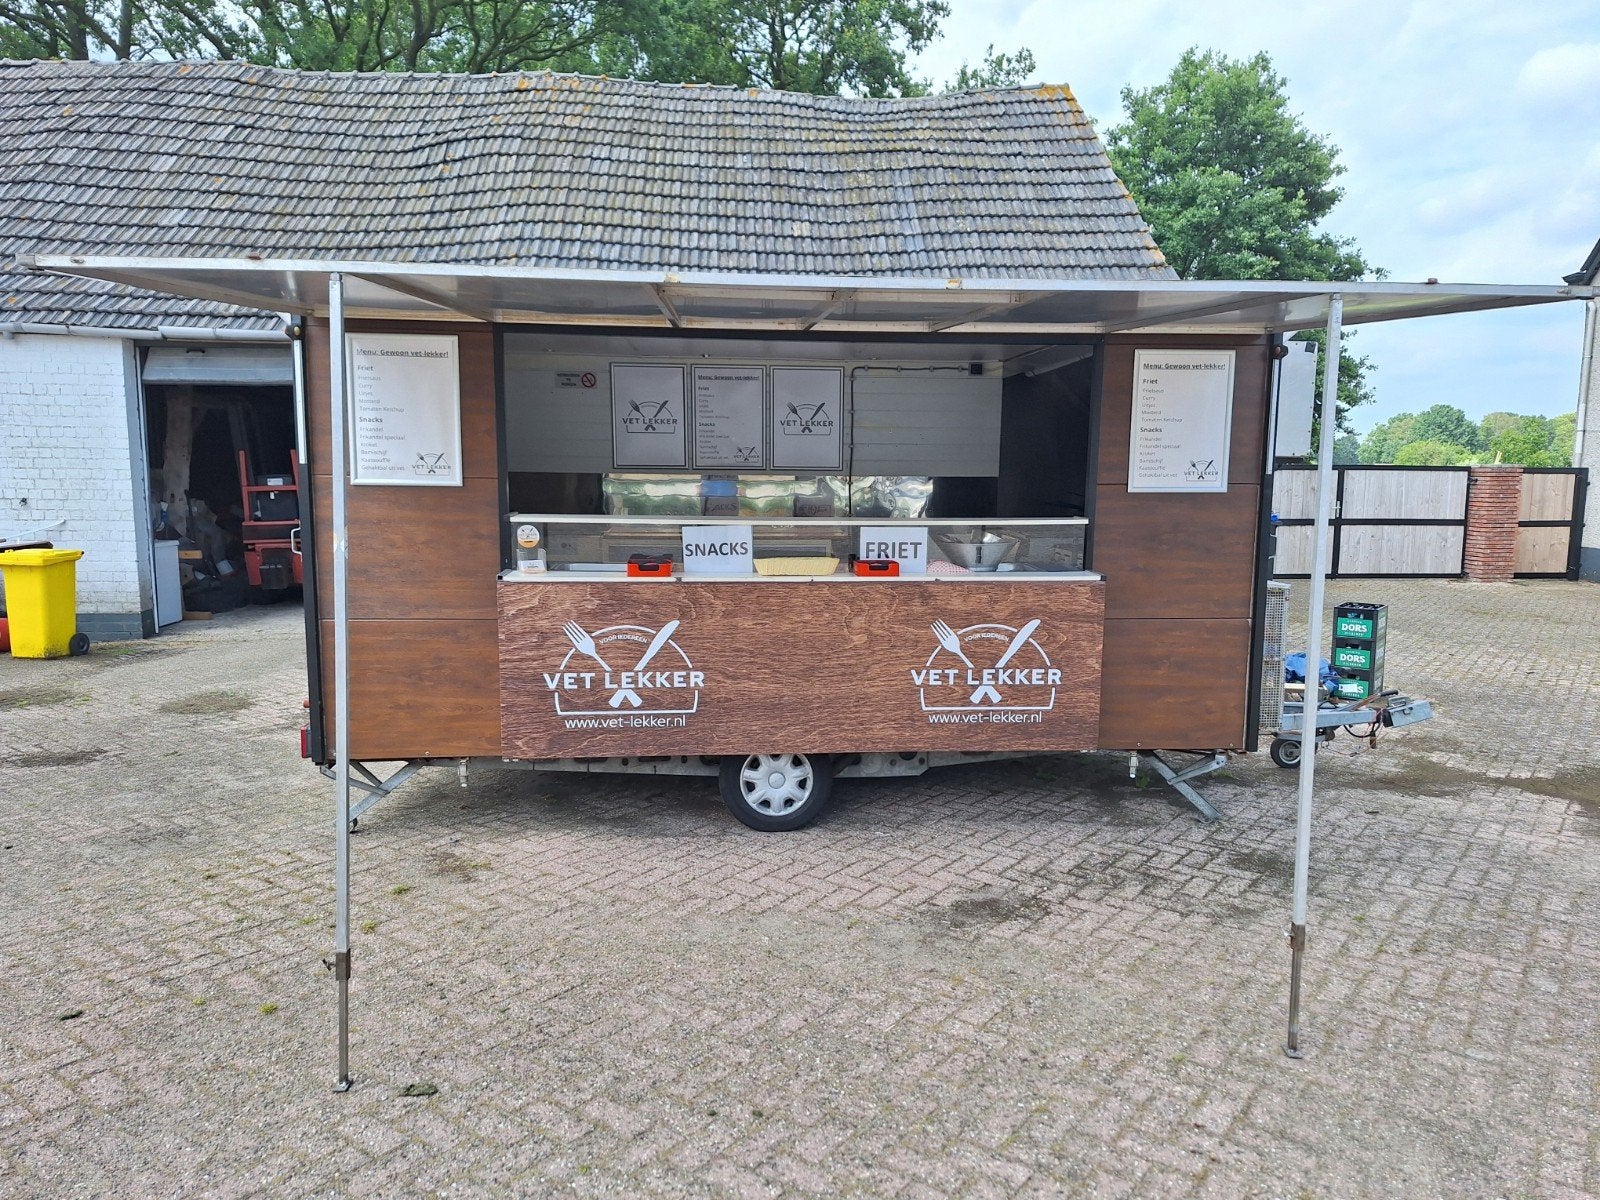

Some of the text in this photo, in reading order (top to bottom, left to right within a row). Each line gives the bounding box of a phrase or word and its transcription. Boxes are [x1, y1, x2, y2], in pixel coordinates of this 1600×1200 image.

[380, 349, 409, 357] Gewoon
[684, 541, 749, 557] SNACKS
[865, 541, 923, 559] FRIET
[1341, 623, 1368, 633] DORS
[599, 634, 648, 644] VOOR IEDEREEN
[1339, 653, 1366, 663] DORS
[543, 671, 705, 690] VET LEKKER
[910, 668, 1063, 686] VET LEKKER
[564, 715, 686, 729] www.vet-lekker.nl
[928, 711, 1042, 724] www.vet-lekker.nl
